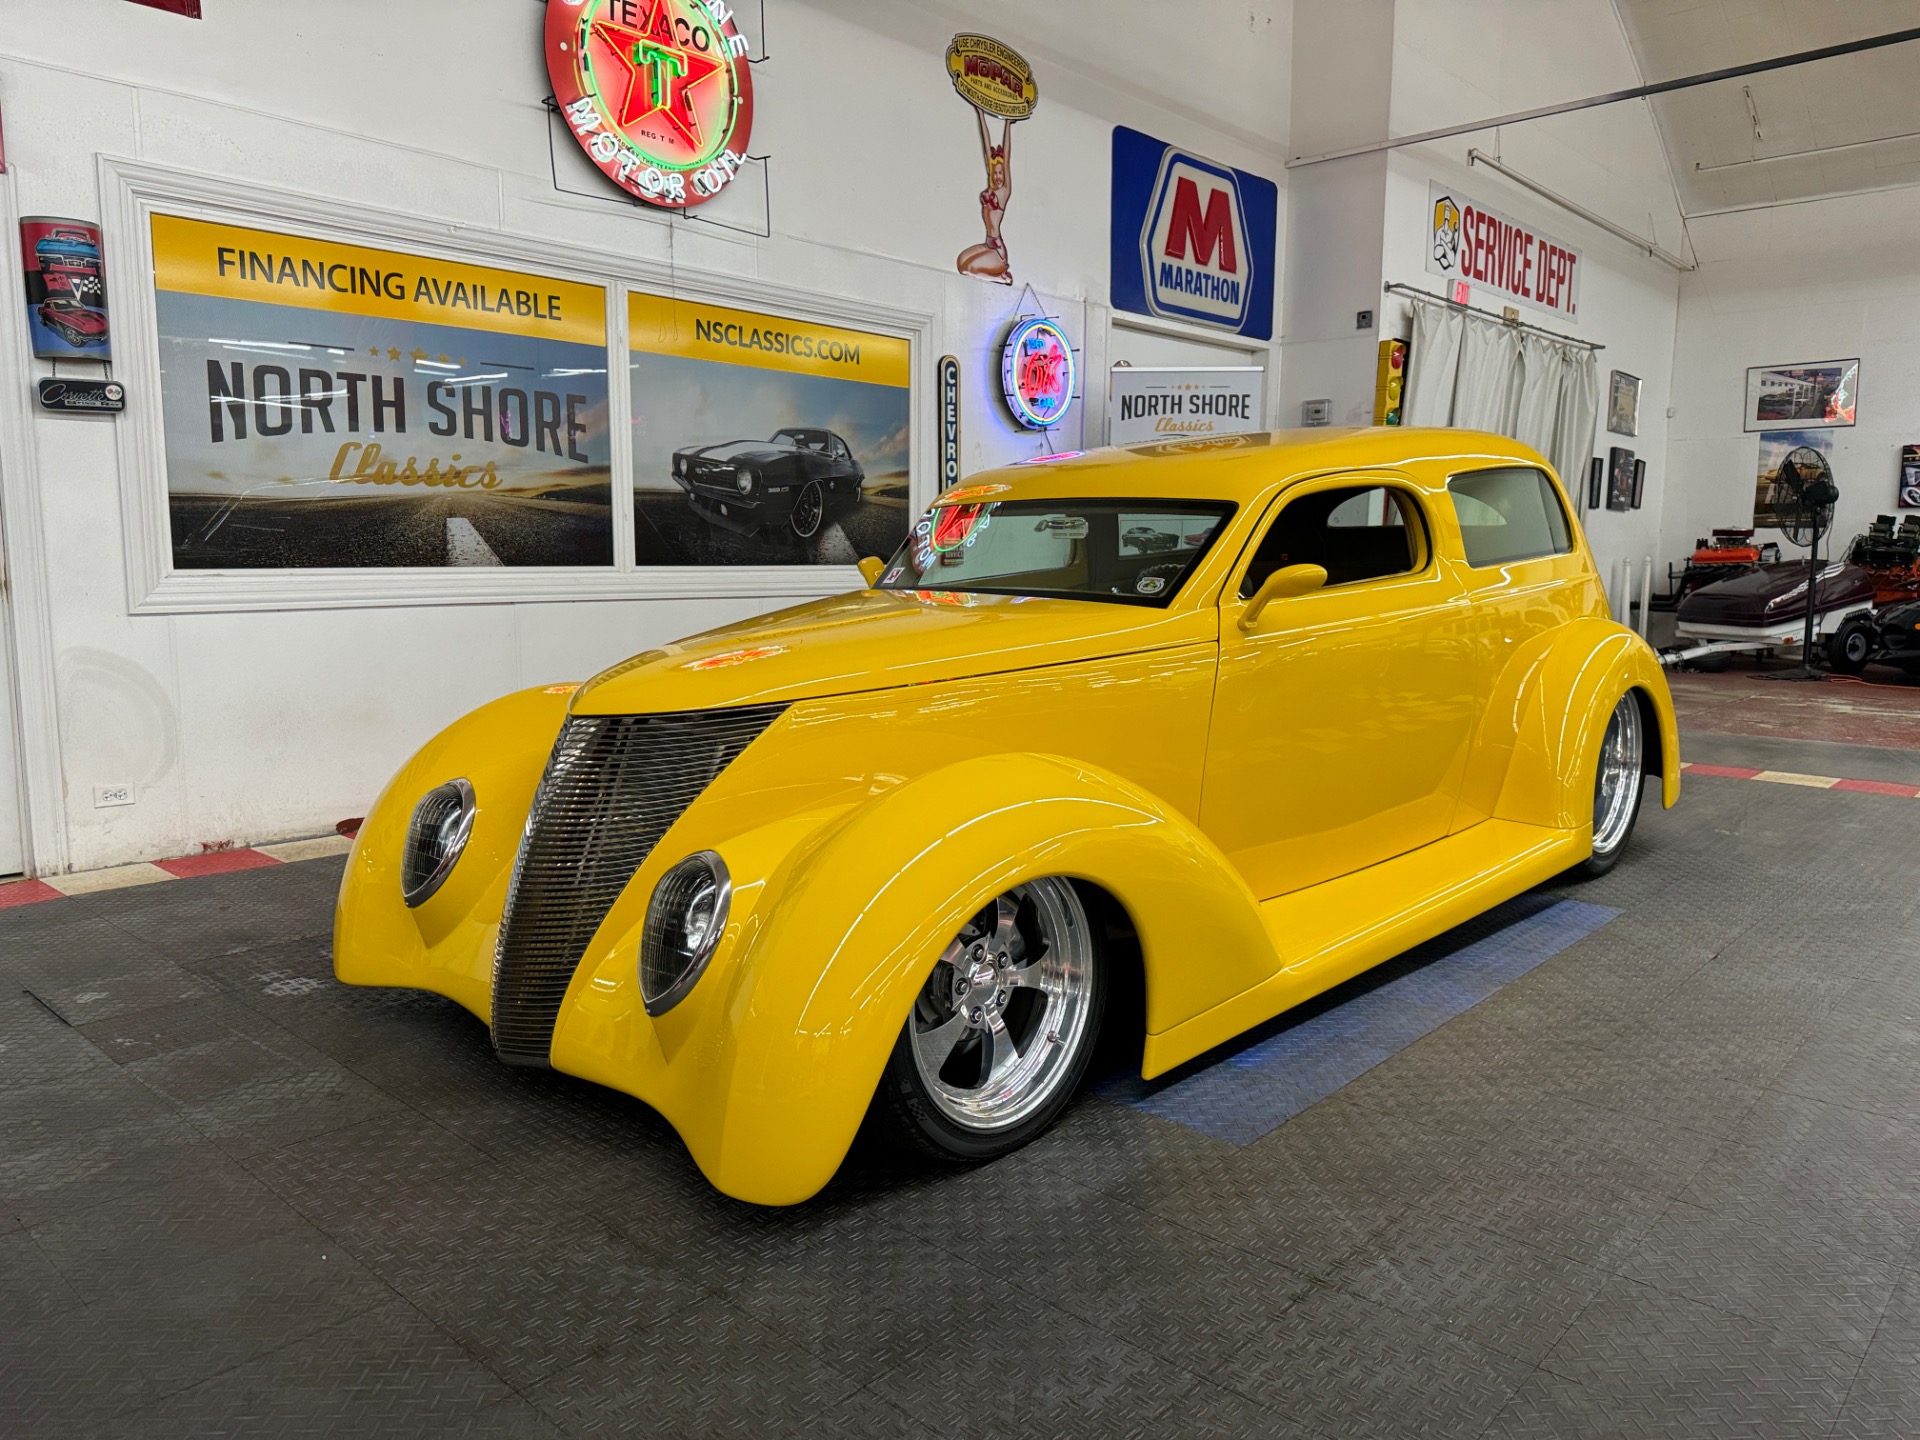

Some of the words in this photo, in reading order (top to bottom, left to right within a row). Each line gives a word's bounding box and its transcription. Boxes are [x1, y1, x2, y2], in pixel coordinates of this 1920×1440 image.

[607, 0, 710, 51] TEXACO
[959, 38, 969, 48] USE
[970, 38, 996, 54] CHRYSLER
[996, 46, 1027, 74] ENGINEERED
[971, 78, 983, 88] PARTS
[566, 97, 686, 204] MOTOR
[694, 149, 747, 196] OIL
[1163, 175, 1238, 274] M
[217, 246, 406, 300] FINANCING
[413, 276, 563, 321] AVAILABLE
[1159, 261, 1240, 306] MARATHON
[1460, 205, 1534, 298] SERVICE
[1535, 239, 1577, 315] DEPT.
[695, 318, 861, 365] NSCLASSICS.COM
[41, 383, 107, 404] Corvette
[206, 359, 407, 443] NORTH
[426, 380, 590, 464] SHORE
[1120, 394, 1183, 421] NORTH
[1189, 394, 1251, 420] SHORE
[1154, 416, 1215, 433] Classics
[329, 441, 503, 489] Classics
